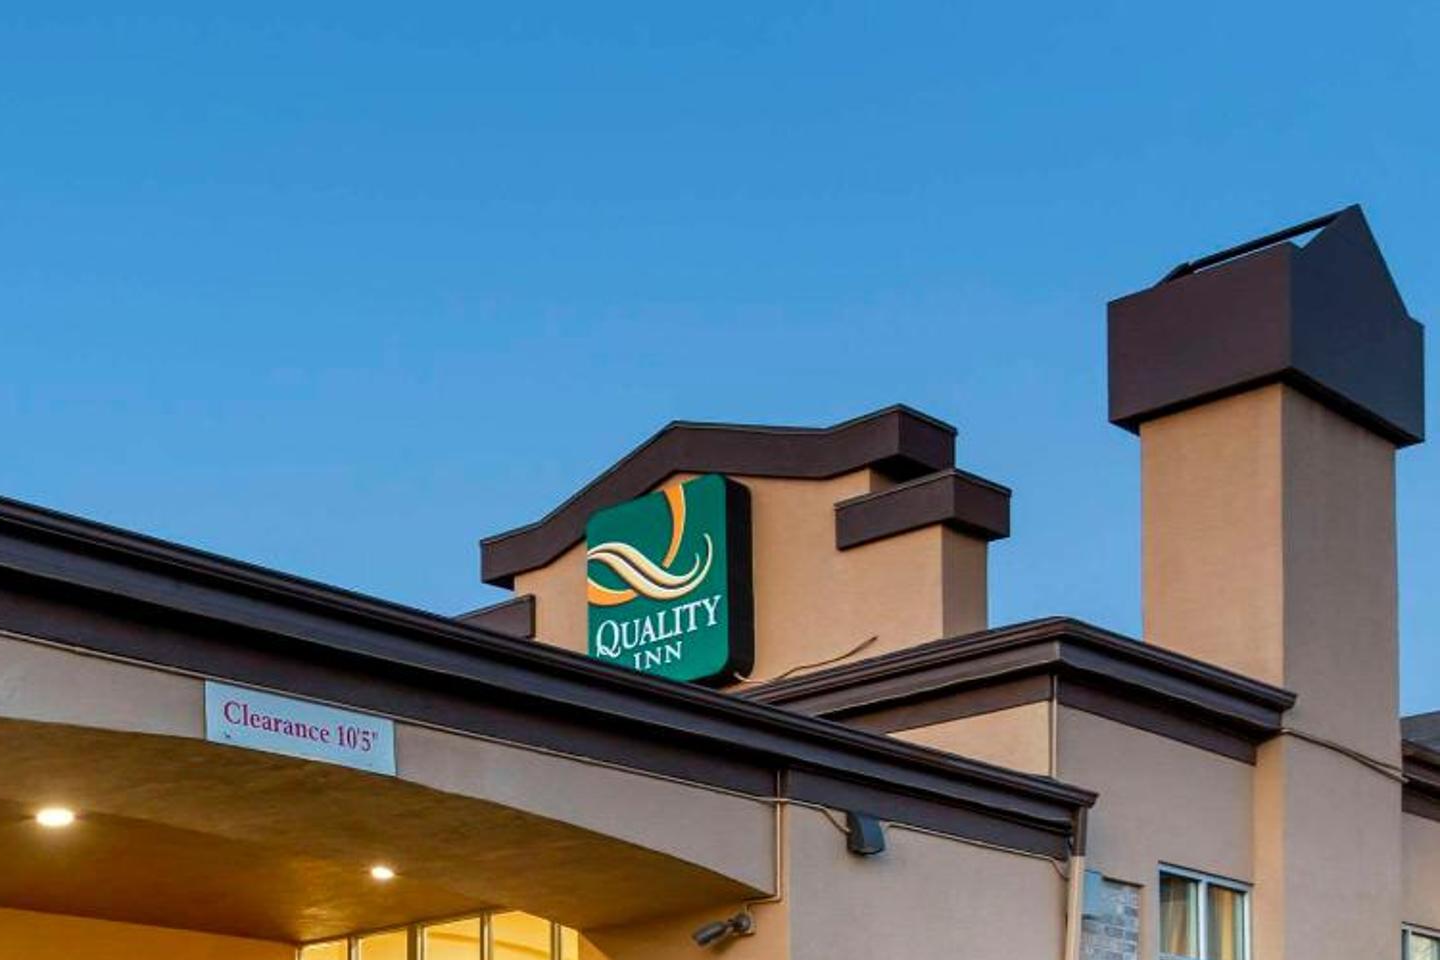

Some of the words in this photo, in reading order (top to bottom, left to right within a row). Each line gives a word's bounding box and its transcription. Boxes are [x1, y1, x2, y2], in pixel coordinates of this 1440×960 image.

[596, 594, 722, 659] QUALITY
[633, 641, 682, 671] INN
[223, 701, 330, 743] Clearance
[337, 724, 378, 752] 10'5"
